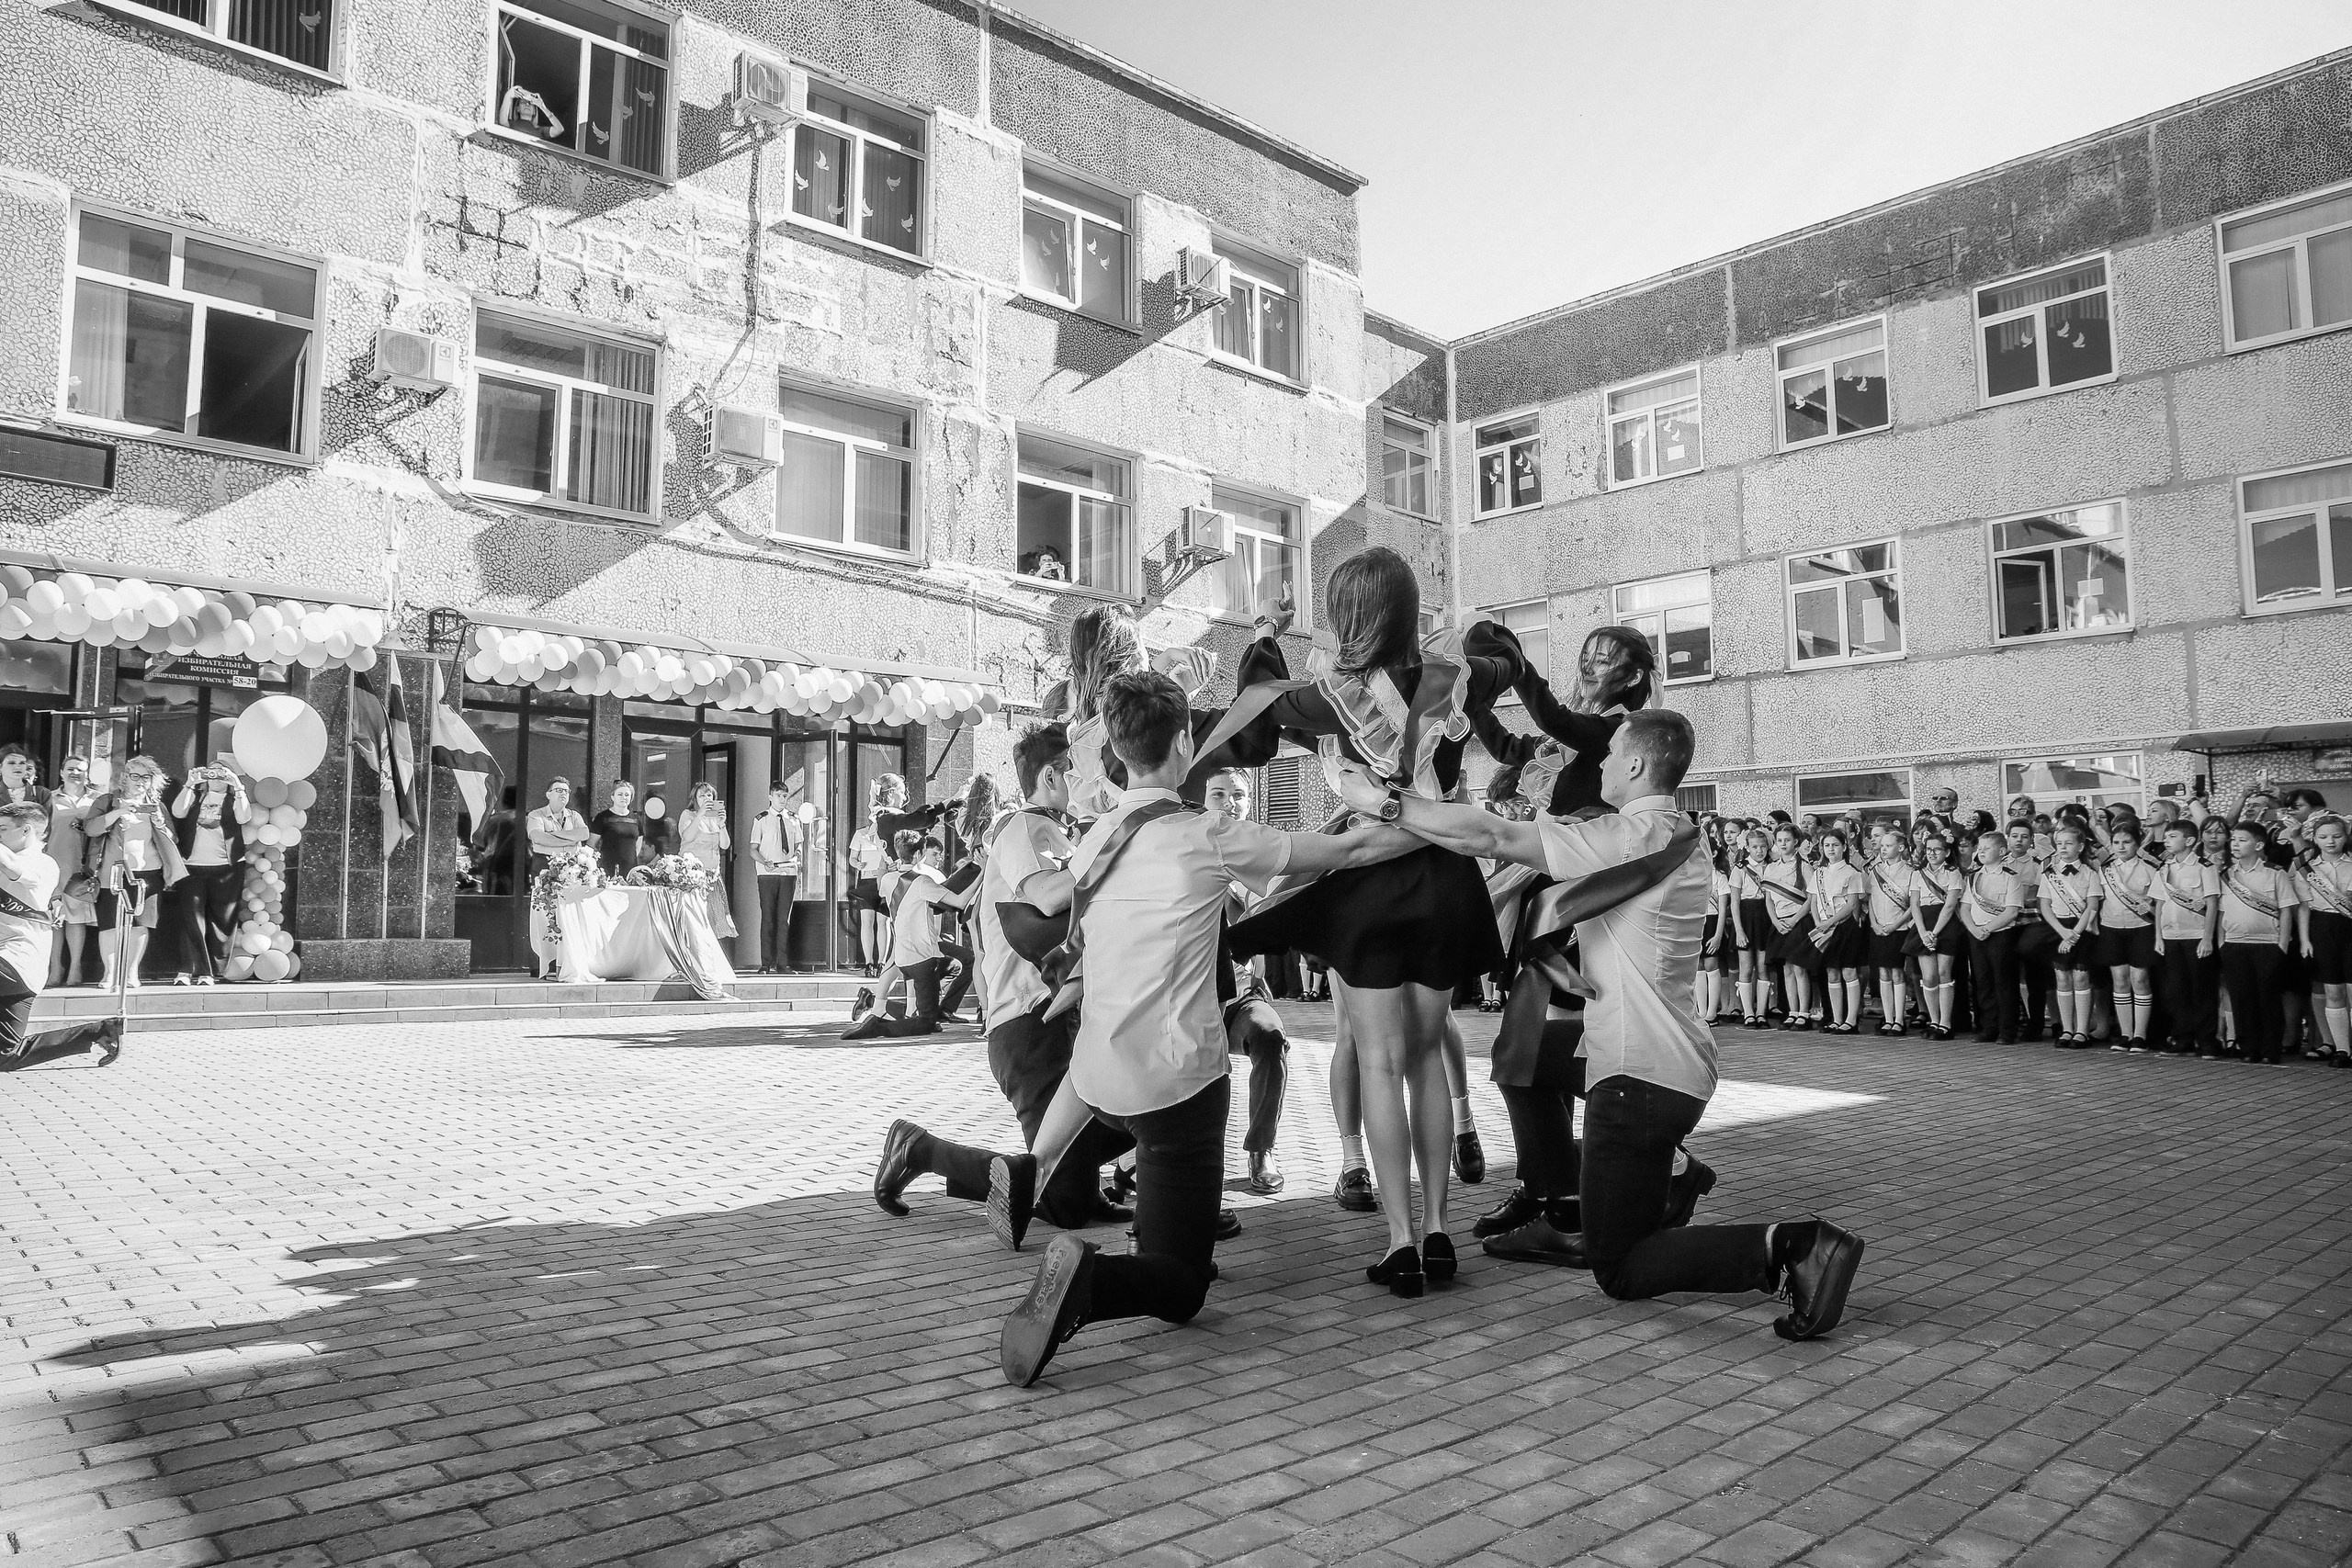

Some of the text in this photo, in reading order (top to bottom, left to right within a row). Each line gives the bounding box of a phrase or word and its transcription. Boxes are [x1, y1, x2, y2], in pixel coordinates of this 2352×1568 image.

[178, 657, 252, 670] ИЗБИРАТЕЛЬНАЯ
[190, 665, 239, 675] КОМИССИЯ
[233, 678, 256, 686] 58-20
